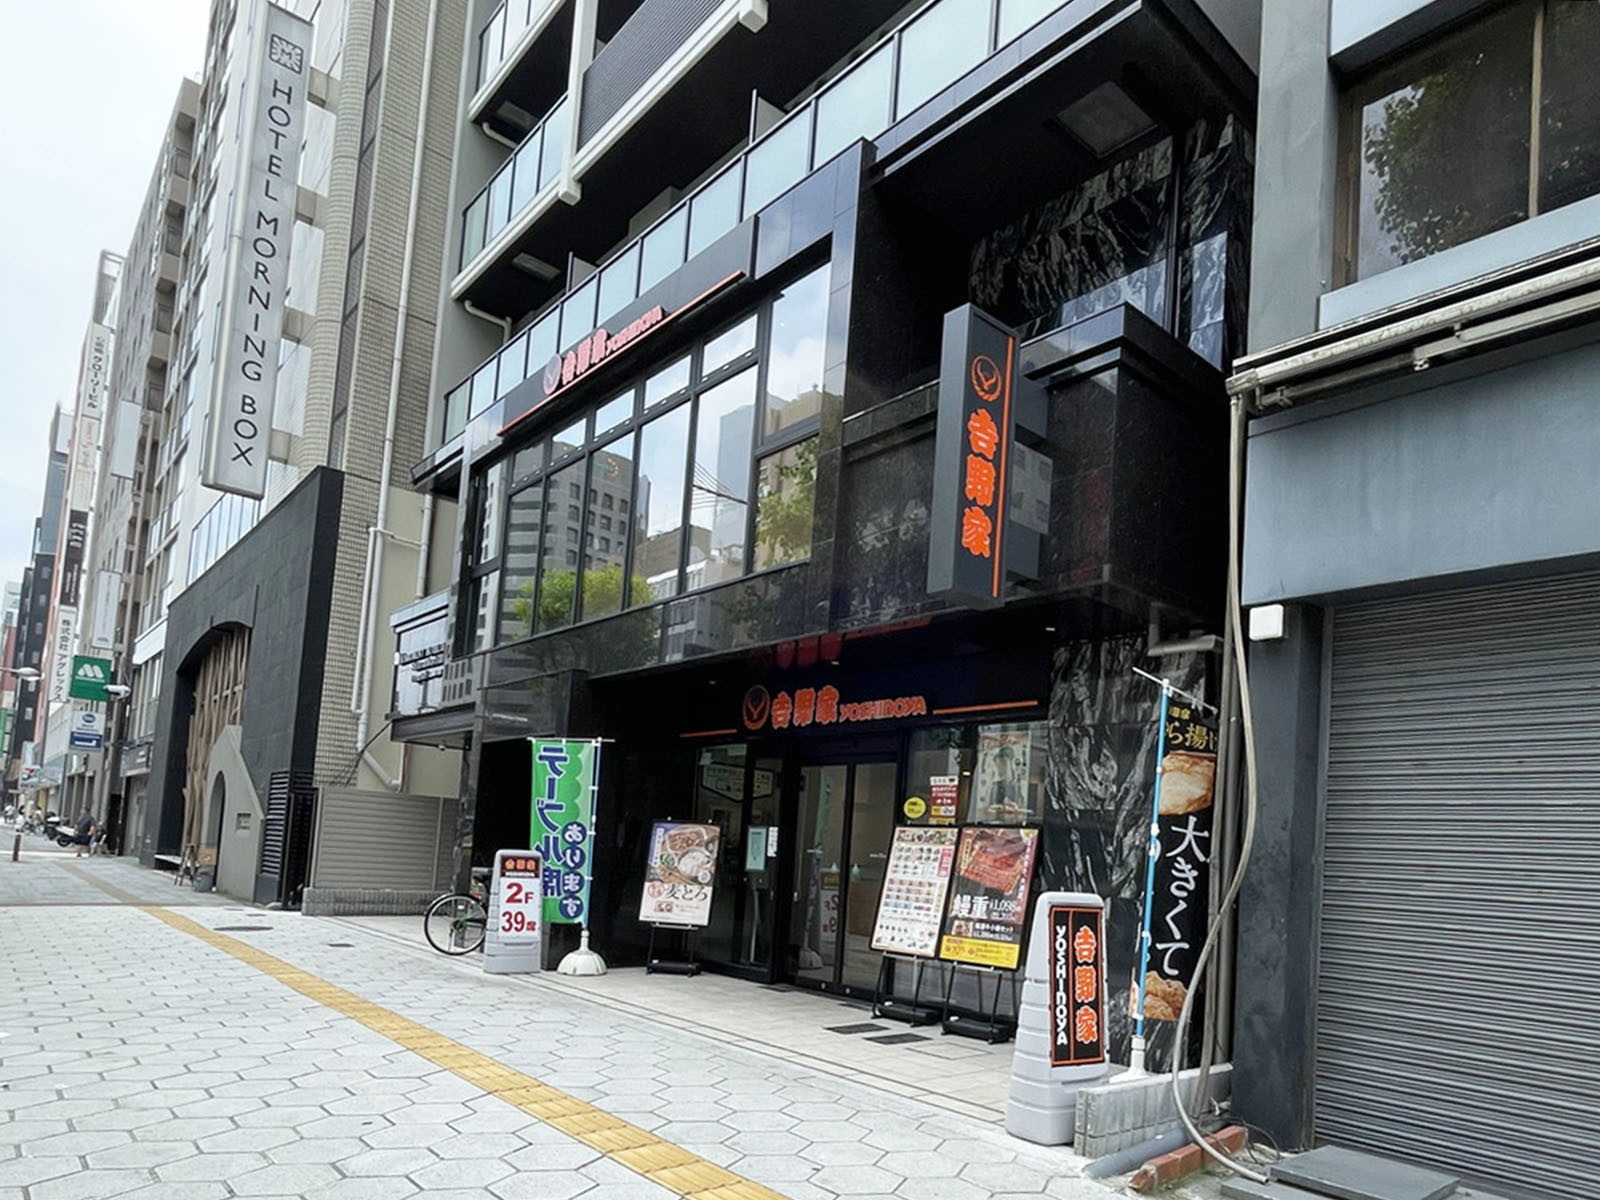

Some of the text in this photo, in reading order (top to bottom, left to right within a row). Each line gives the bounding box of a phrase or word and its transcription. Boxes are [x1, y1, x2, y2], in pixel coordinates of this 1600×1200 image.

[232, 79, 293, 467] HOTEL MORNING BOX
[961, 408, 999, 557] 吉野家
[771, 685, 840, 729] 吉野家
[1166, 720, 1217, 751] ら揚
[506, 882, 534, 904] 2F
[1156, 815, 1210, 976] 大きくて
[1074, 925, 1098, 1043] 吉野家
